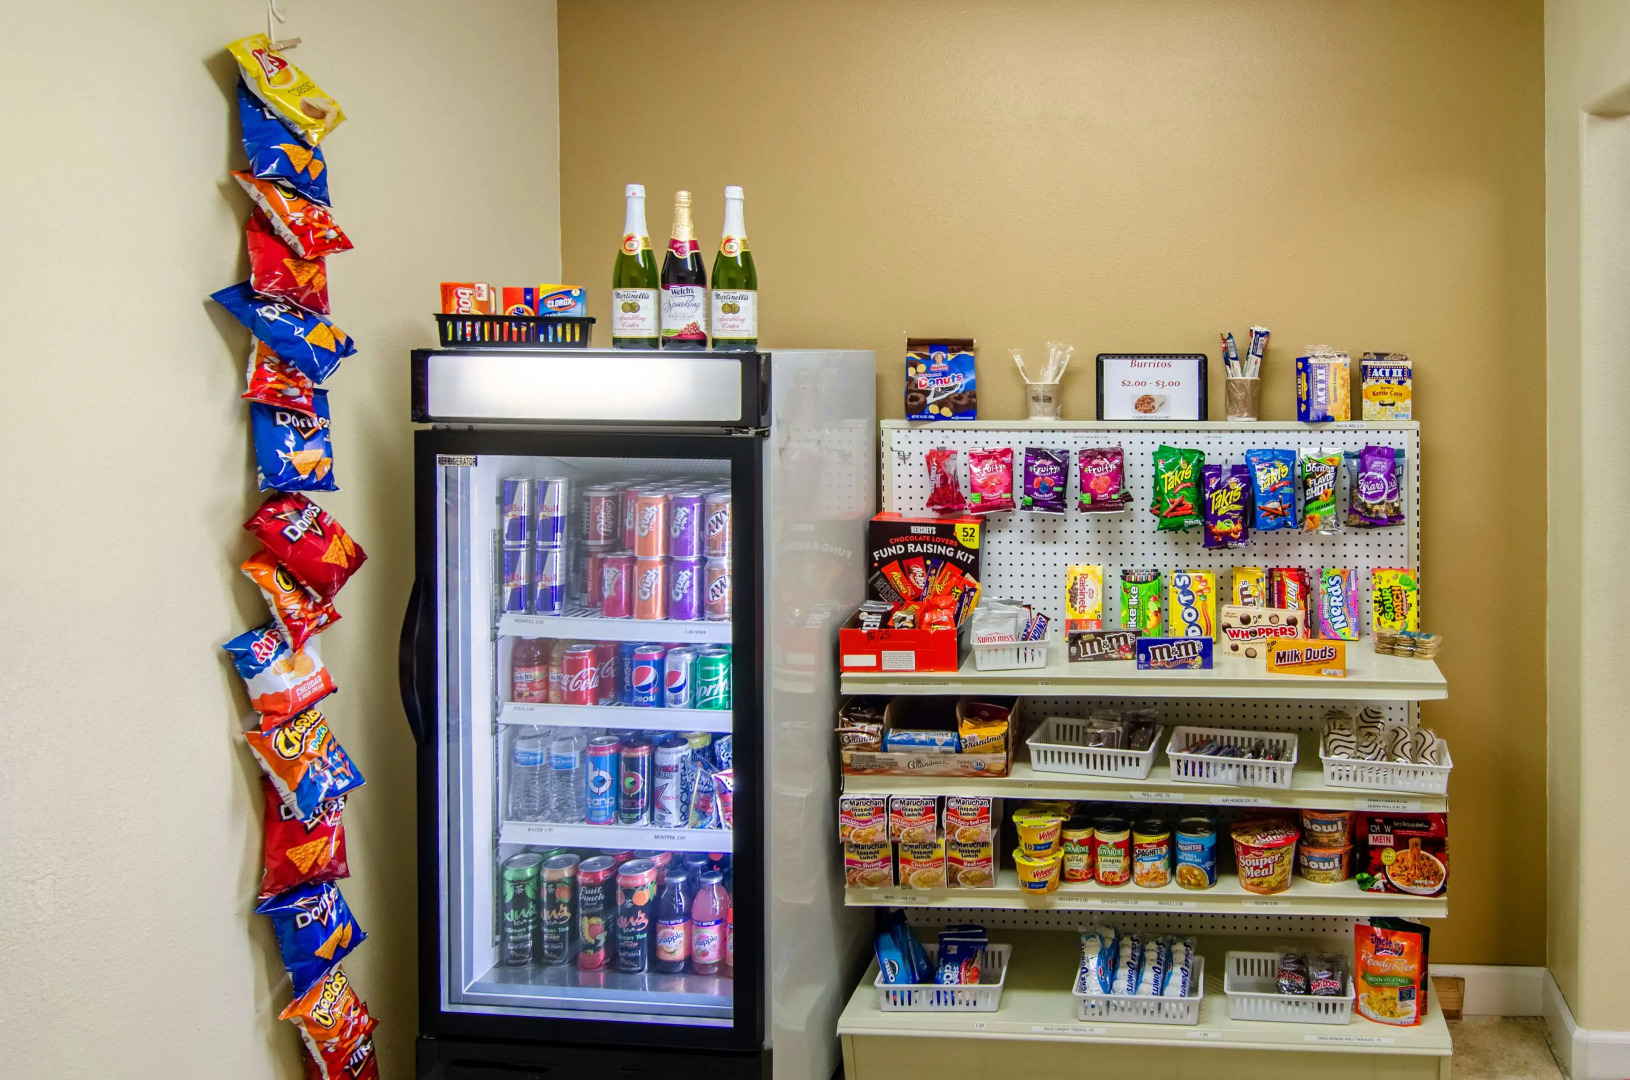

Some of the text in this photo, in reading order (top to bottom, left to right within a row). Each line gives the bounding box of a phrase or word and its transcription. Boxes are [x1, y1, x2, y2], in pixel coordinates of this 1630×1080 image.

[671, 288, 695, 296] Welch's
[547, 299, 573, 308] CLOROX
[664, 299, 701, 313] Sparkling
[1129, 359, 1172, 368] Burritos
[1372, 368, 1391, 377] ACT
[918, 373, 963, 389] Donuts
[1120, 379, 1181, 389] $2.00 $3.00
[1317, 380, 1326, 404] ACT
[438, 457, 476, 466] REFRIGERATOR
[1088, 463, 1114, 474] Fruity
[1305, 463, 1335, 473] Doritos
[1033, 464, 1058, 475] Fruity
[1161, 465, 1192, 493] Takis
[1257, 464, 1289, 493] Takis
[1310, 474, 1335, 488] FLAVOR
[1210, 487, 1242, 514] Takis
[638, 505, 657, 537] Crush
[671, 507, 690, 538] Crush
[910, 526, 936, 534] HERSHEY'S
[962, 527, 976, 538] 52
[889, 535, 958, 547] CHOCOLATE LOVERS
[873, 543, 975, 564] FUND RAISING KIT
[639, 569, 659, 601] Crush
[672, 571, 692, 602] Crush
[1078, 573, 1089, 615] Raisinets
[1174, 574, 1203, 637] DOTS
[1384, 588, 1392, 620] SOUR
[1392, 585, 1402, 621] PATCH
[977, 634, 1014, 643] SWISS MISS
[1227, 625, 1296, 640] WHOPPERS
[1079, 632, 1135, 657] m&m's
[1149, 641, 1204, 661] m&m's
[1275, 646, 1336, 665] Milk Duds
[296, 675, 322, 695] CHEDDAR
[634, 695, 655, 703] pepsi
[309, 726, 327, 750] Puffs
[679, 753, 690, 823] ROCKSTAR
[587, 796, 615, 807] bang
[1303, 818, 1343, 833] Bowl
[1372, 835, 1391, 844] MEIN
[1098, 847, 1125, 856] BOYARDEE
[1178, 843, 1203, 851] PROGRESSO
[863, 861, 883, 869] Shrimp
[1066, 856, 1084, 864] Ravioli
[1239, 854, 1280, 867] Souper
[1299, 854, 1340, 870] Bowl
[1244, 864, 1274, 878] Meal
[580, 893, 605, 902] Punch
[581, 886, 602, 895] Fruit
[657, 932, 684, 944] Snapple
[1371, 933, 1393, 948] Uncle
[1126, 936, 1140, 993] SUGAR DONUTS
[1152, 940, 1165, 996] SUGAR DONUTS
[1361, 950, 1415, 973] Ready Rice
[1180, 941, 1192, 997] SUGAR DONUTS
[1311, 980, 1340, 992] DING DONGS
[1384, 976, 1409, 984] VEGETABLE
